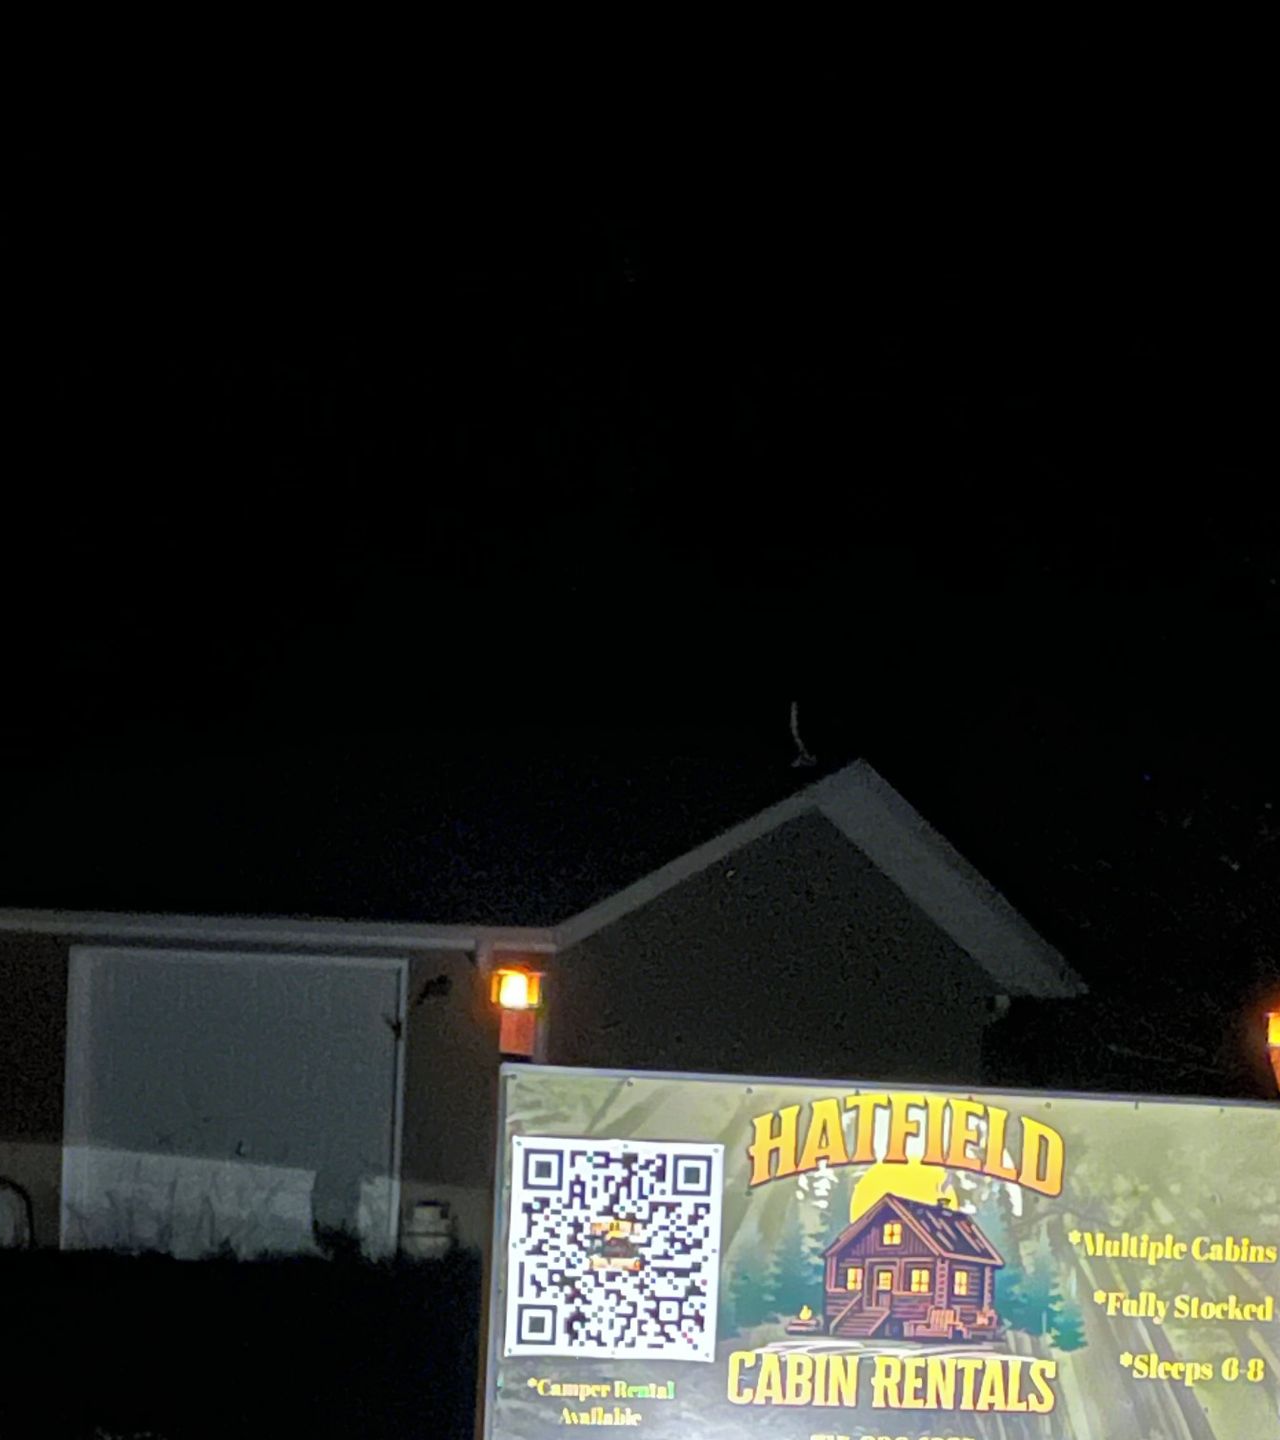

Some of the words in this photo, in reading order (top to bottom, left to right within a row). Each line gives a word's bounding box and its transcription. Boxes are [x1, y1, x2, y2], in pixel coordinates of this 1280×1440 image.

[748, 1092, 1065, 1198] HATFIELD
[1191, 1236, 1278, 1263] Cabins
[1173, 1294, 1273, 1321] Stocked
[727, 1351, 859, 1407] CABIN
[871, 1355, 1056, 1413] RENTALS
[1221, 1357, 1265, 1382] 6-8
[614, 1380, 675, 1399] Rental
[560, 1407, 642, 1426] Available
